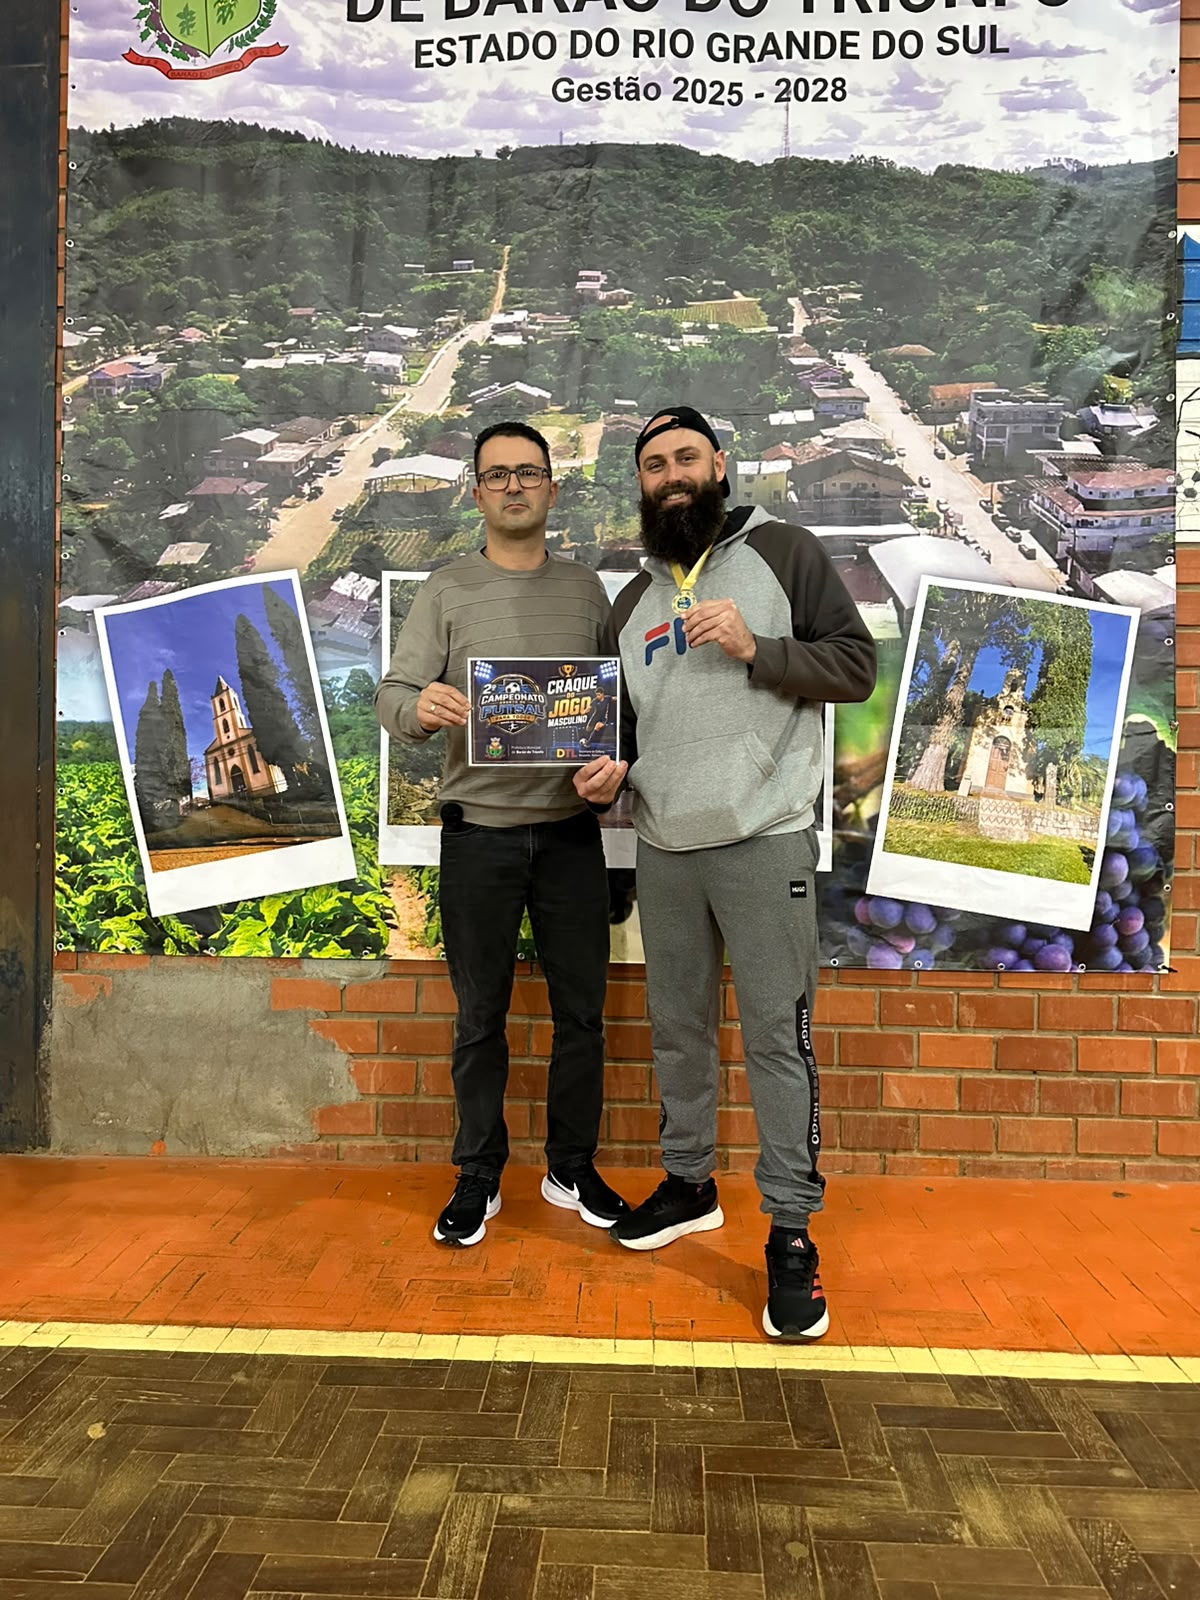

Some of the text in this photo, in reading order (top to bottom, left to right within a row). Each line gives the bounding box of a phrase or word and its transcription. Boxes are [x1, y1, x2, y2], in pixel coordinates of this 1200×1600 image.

[415, 24, 1010, 68] ESTADO DO RIO GRANDE DO SUL
[551, 76, 847, 106] Gestão 2025 - 2028
[547, 675, 598, 695] CRAQUE
[481, 693, 545, 705] CAMPEONATO
[548, 696, 592, 718] JOGO
[481, 703, 545, 719] FUTSAL
[548, 715, 588, 727] MASCULINO
[556, 748, 577, 758] DTL
[801, 1008, 811, 1050] HUGO
[811, 1102, 820, 1145] HUGO
